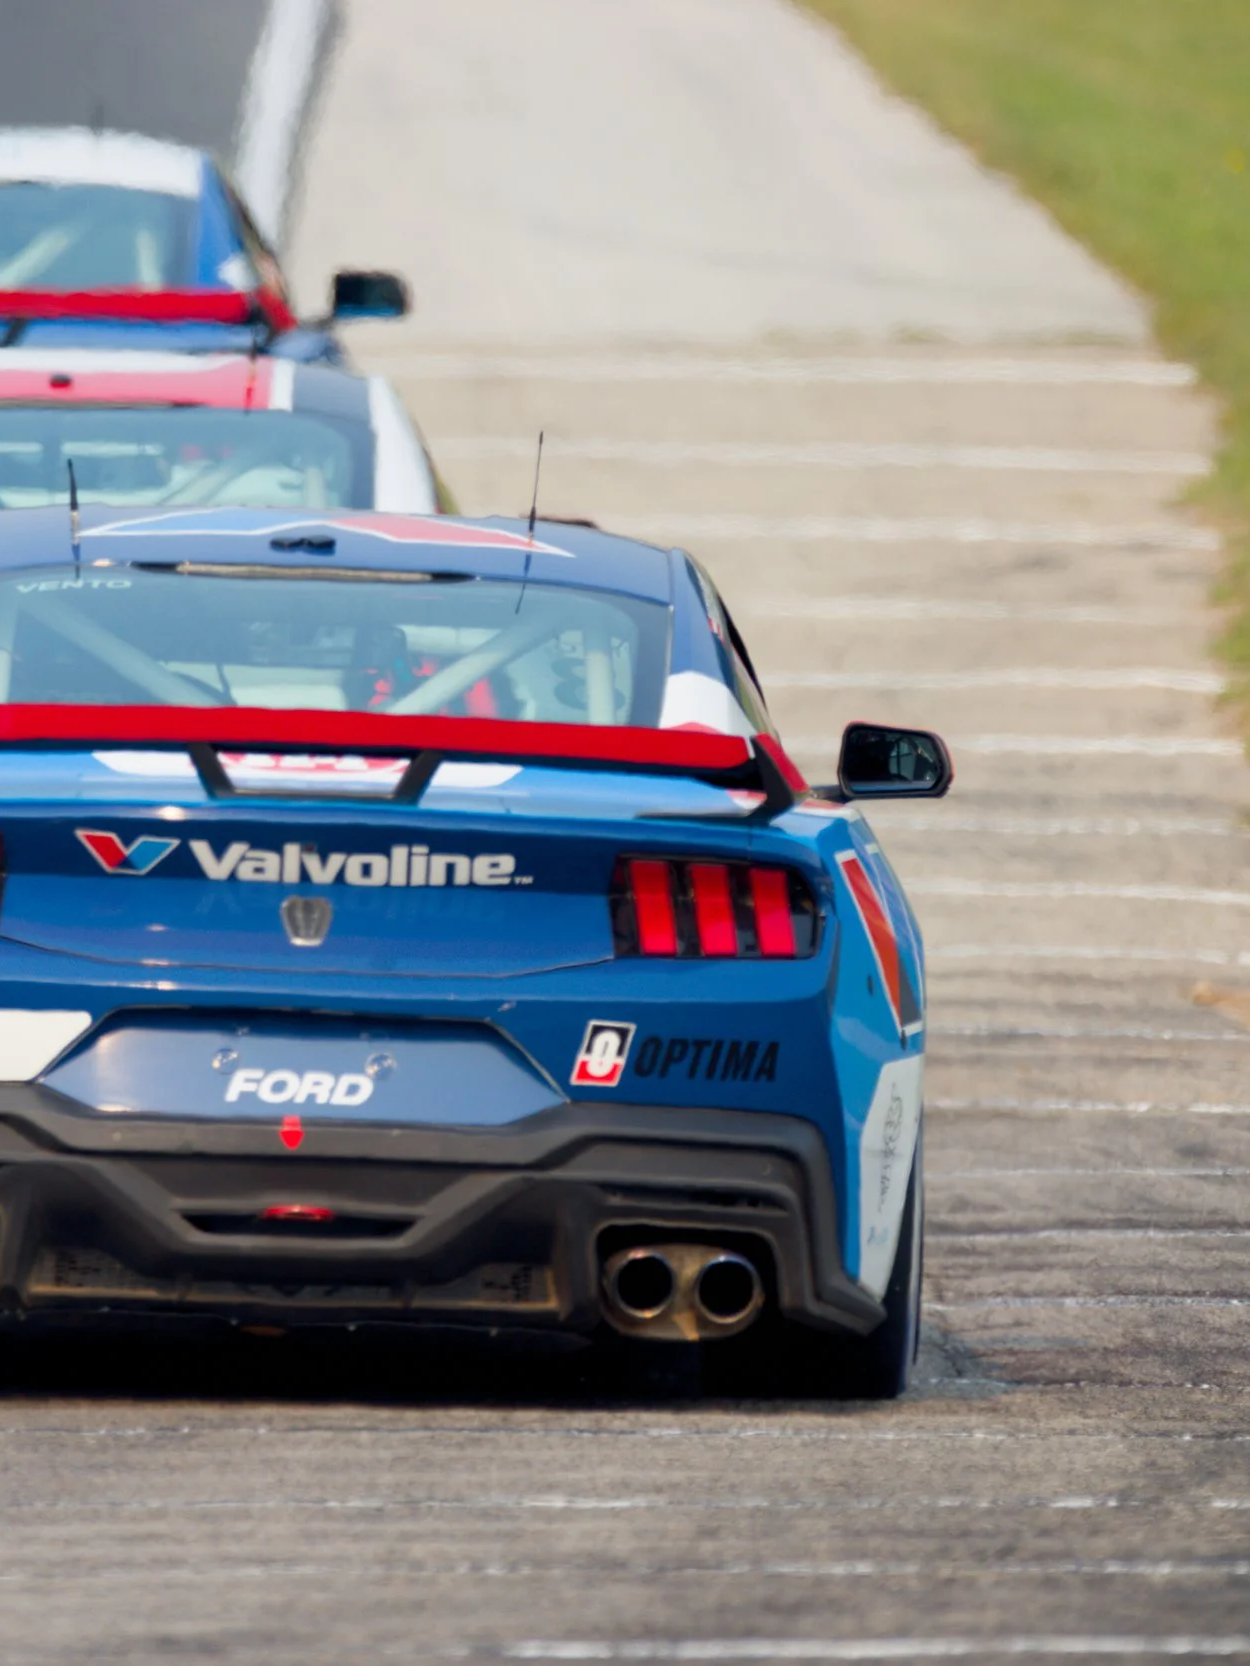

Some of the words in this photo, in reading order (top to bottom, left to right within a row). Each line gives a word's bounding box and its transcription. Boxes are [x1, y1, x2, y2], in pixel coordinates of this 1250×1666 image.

[16, 579, 132, 593] VENTO
[189, 839, 516, 887] Valvoline
[634, 1035, 780, 1083] OPTIMA
[225, 1069, 374, 1106] FORD
